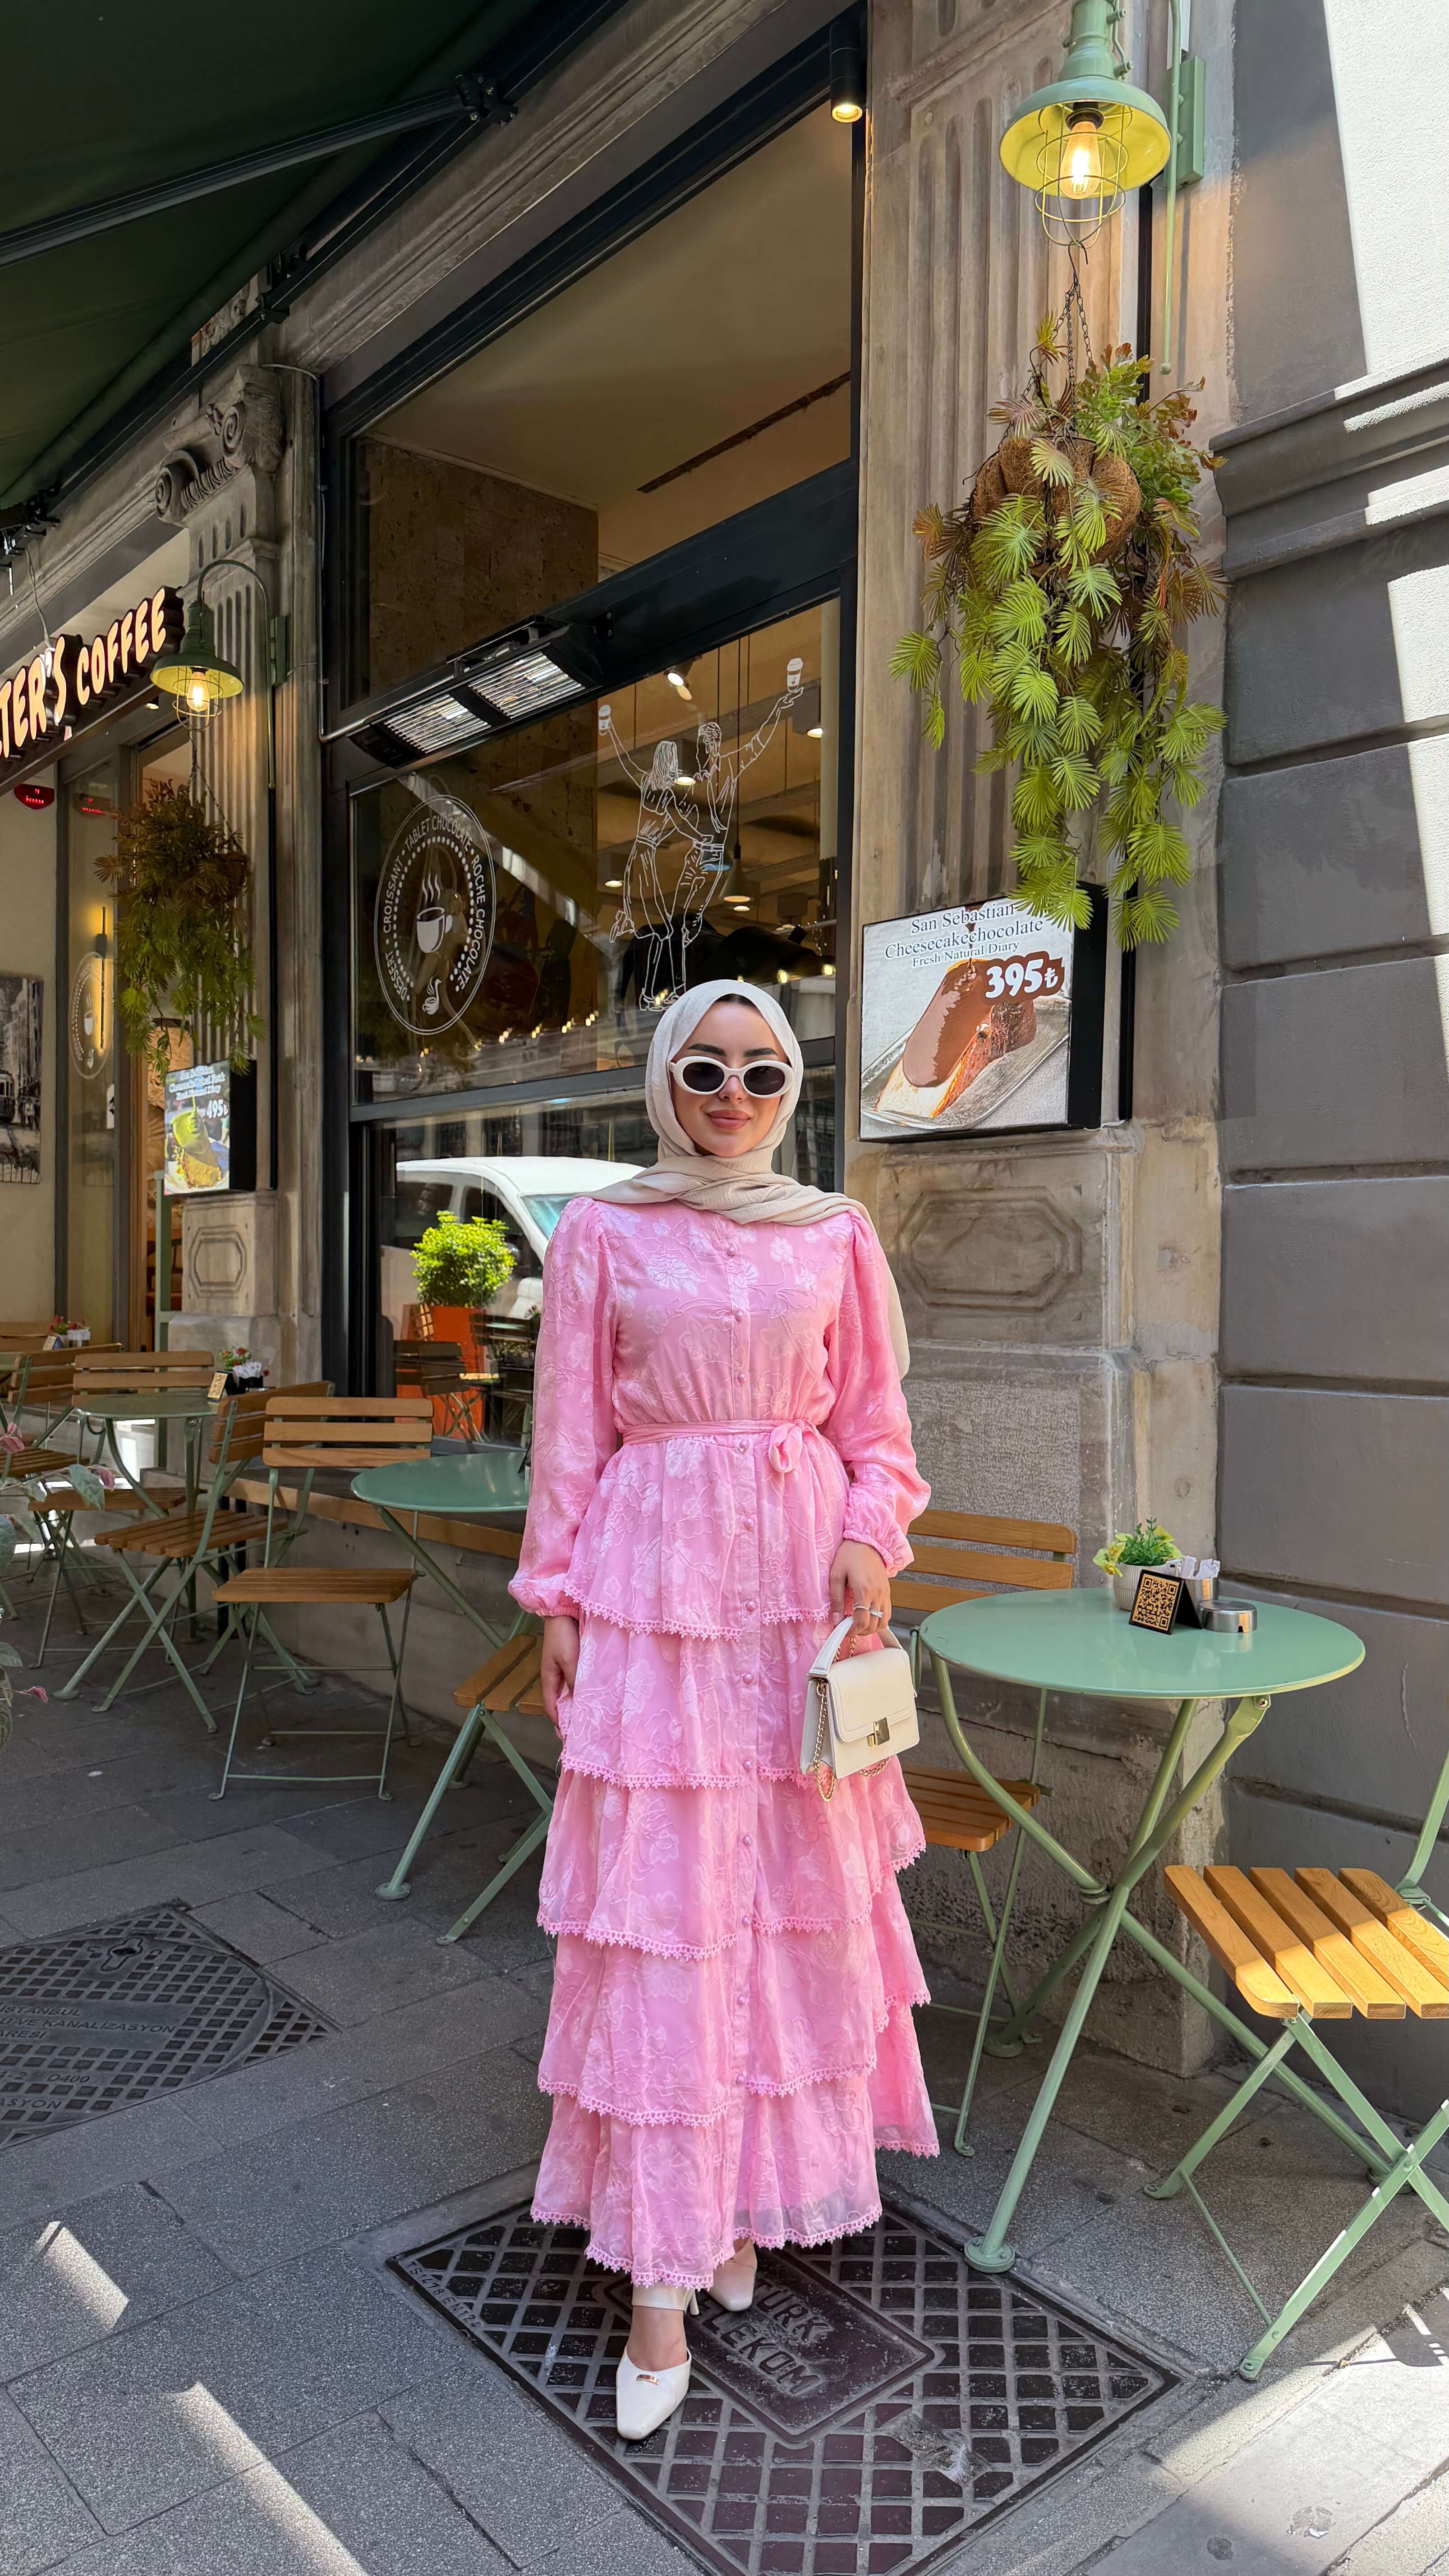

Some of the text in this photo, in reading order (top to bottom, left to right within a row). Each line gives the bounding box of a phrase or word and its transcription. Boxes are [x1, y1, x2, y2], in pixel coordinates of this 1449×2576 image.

[0, 588, 166, 758] TER'S COFFEE
[383, 815, 485, 1000] DESSERT CROISSANT TABLET CHOCOLATE ROCHE CHOCOLATE
[911, 903, 1014, 934] San Sebastian
[885, 920, 1043, 959] Cheesecakechocolate
[913, 941, 1020, 966] Fresh Natural Diary
[47, 2074, 90, 2083] D400
